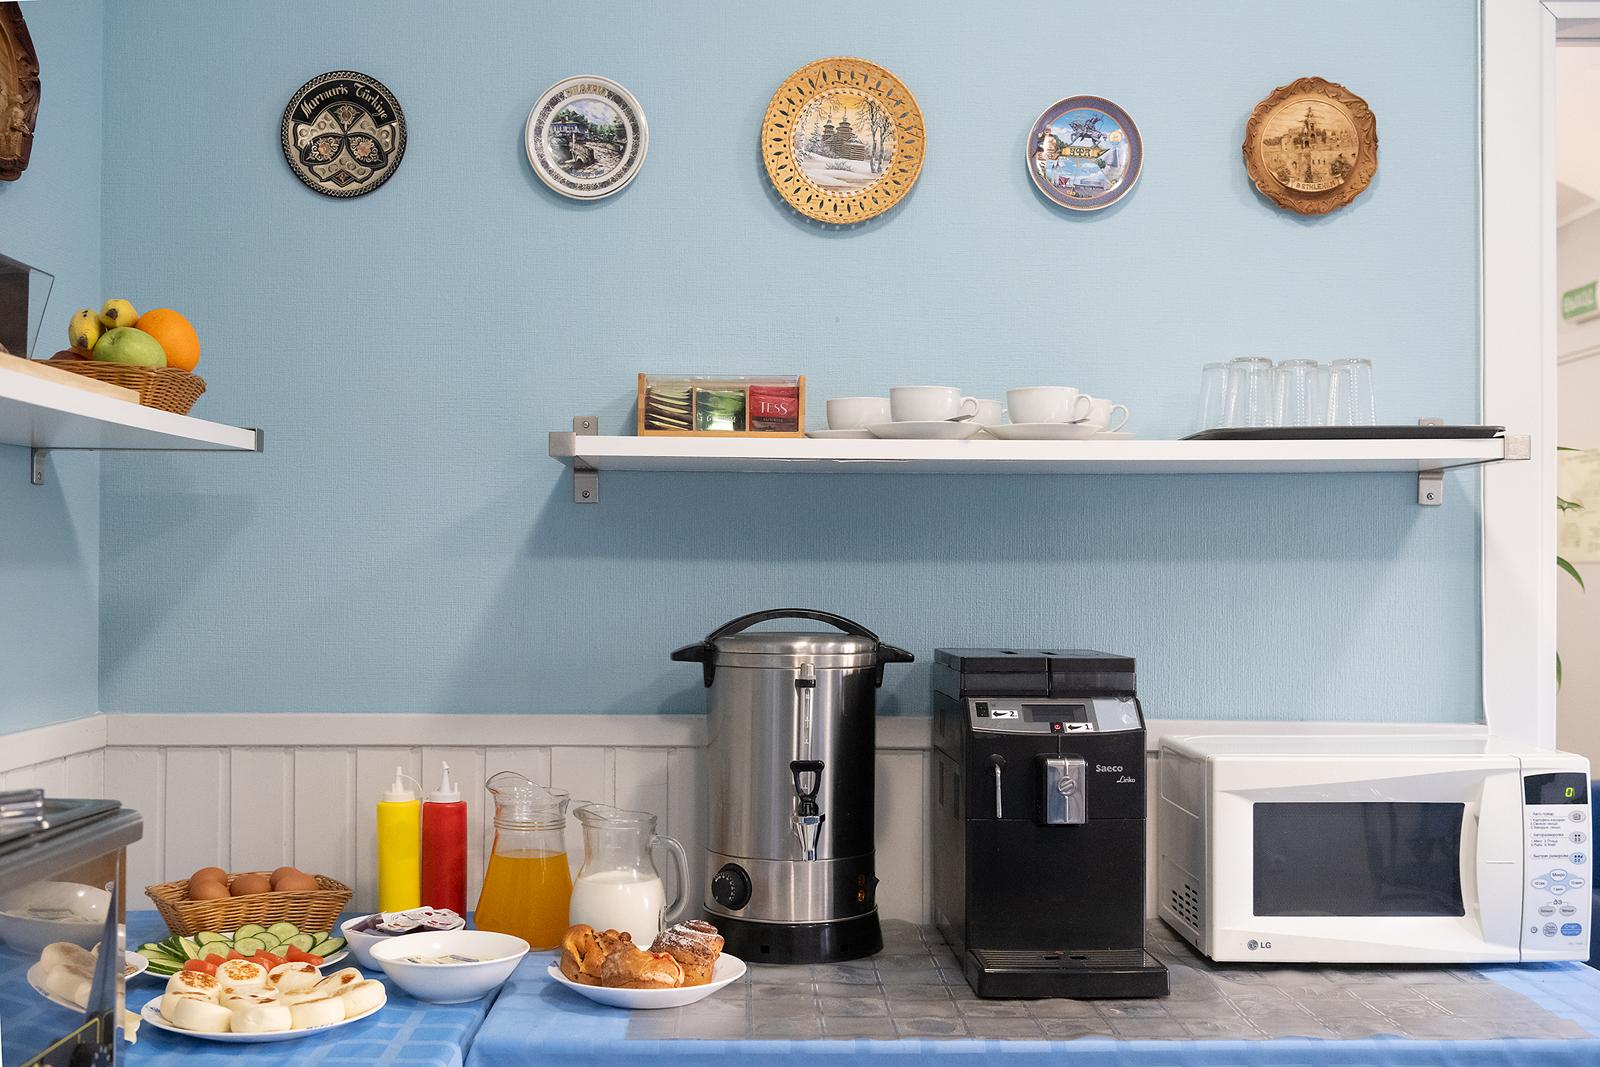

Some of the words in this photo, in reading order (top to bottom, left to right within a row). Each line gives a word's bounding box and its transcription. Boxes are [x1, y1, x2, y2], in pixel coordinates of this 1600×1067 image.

[300, 83, 349, 119] Marmaris
[353, 82, 388, 121] Türkiye
[760, 401, 788, 415] TESS
[1095, 764, 1124, 773] Saeco
[1565, 786, 1575, 798] 0
[1260, 941, 1272, 949] LG
